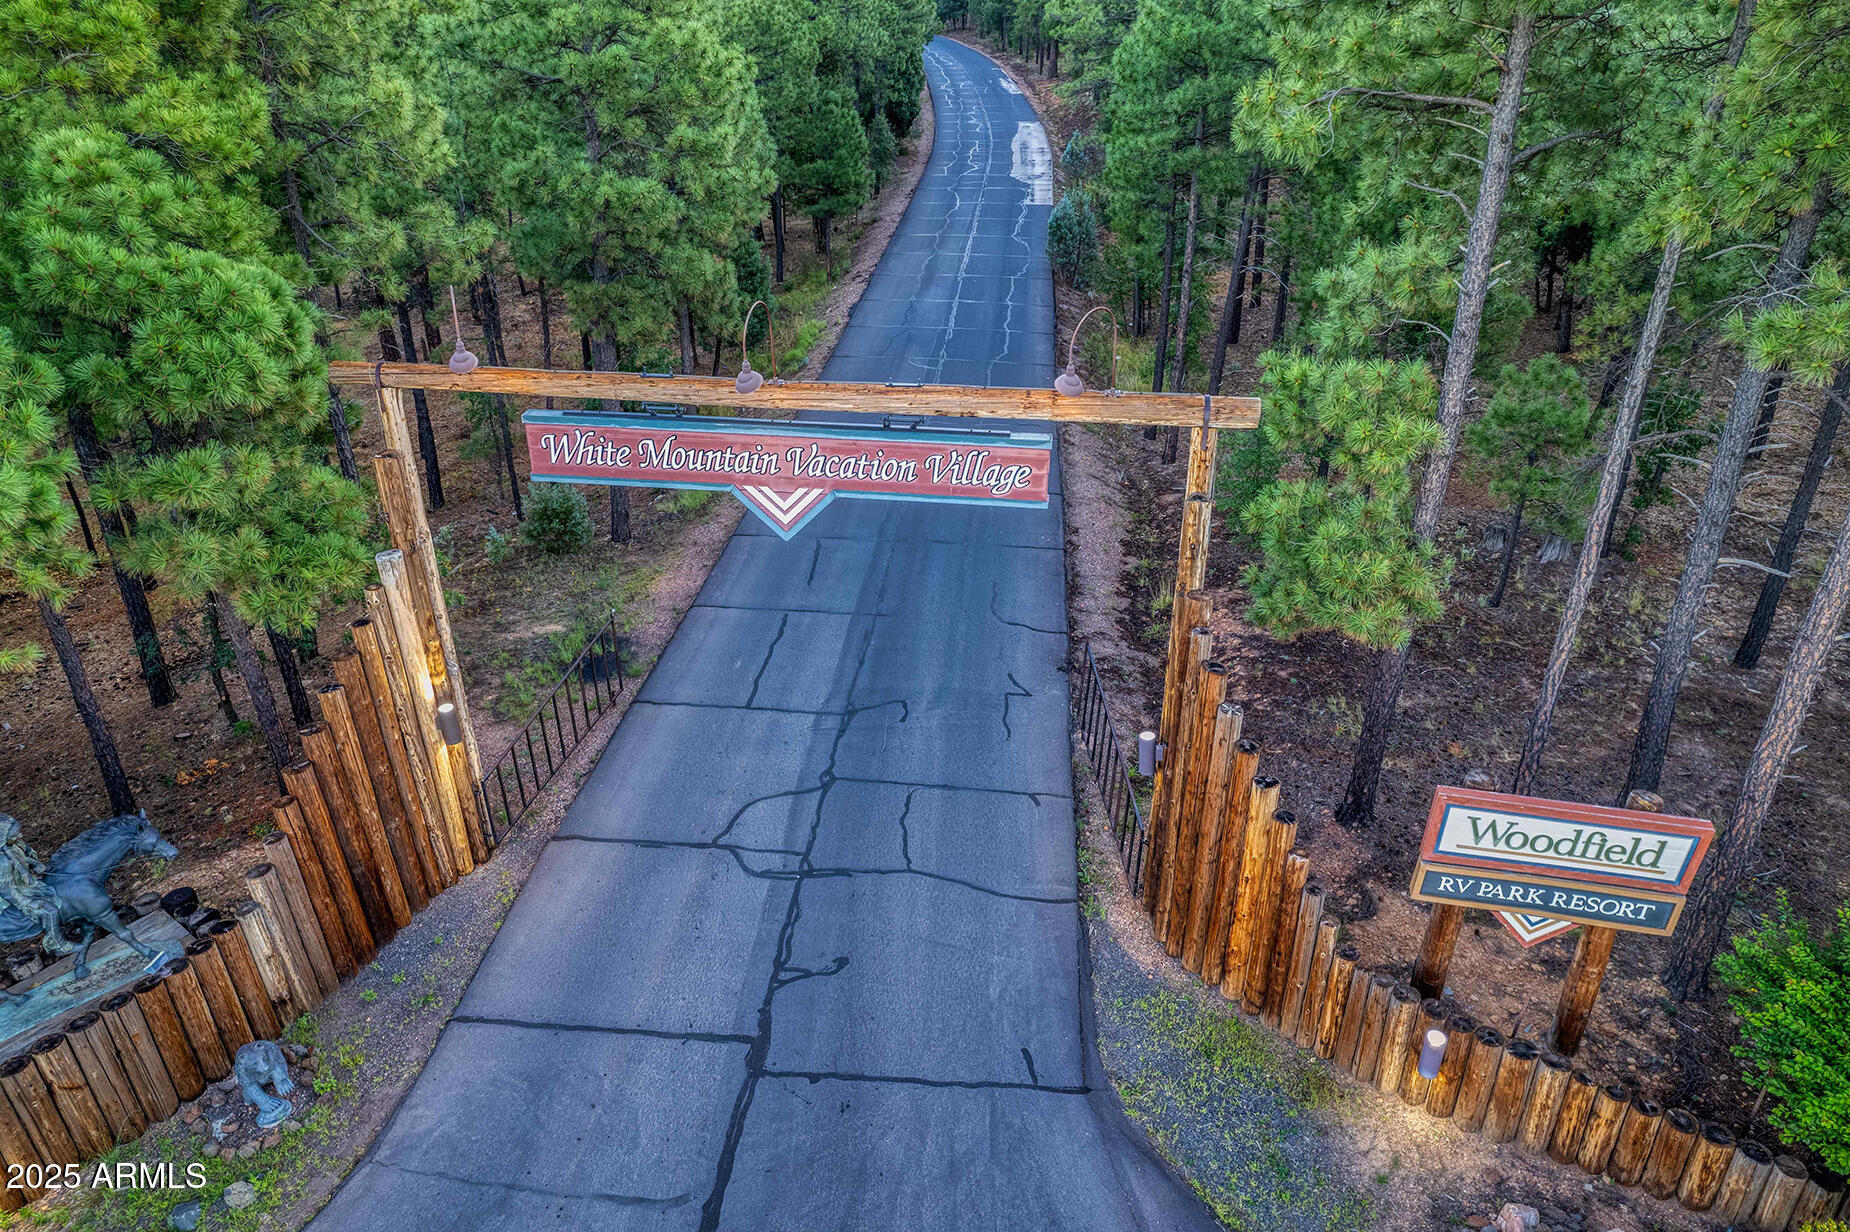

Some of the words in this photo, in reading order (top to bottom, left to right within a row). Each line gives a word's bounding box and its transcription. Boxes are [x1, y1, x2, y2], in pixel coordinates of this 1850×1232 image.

[541, 428, 631, 467] White
[637, 437, 779, 475] Mountain
[785, 444, 917, 483] Vacation
[924, 452, 1032, 495] Village
[1467, 816, 1668, 869] Woodfield
[1437, 876, 1474, 893] RV
[1477, 881, 1546, 905] PARK
[1549, 891, 1656, 920] RESORT
